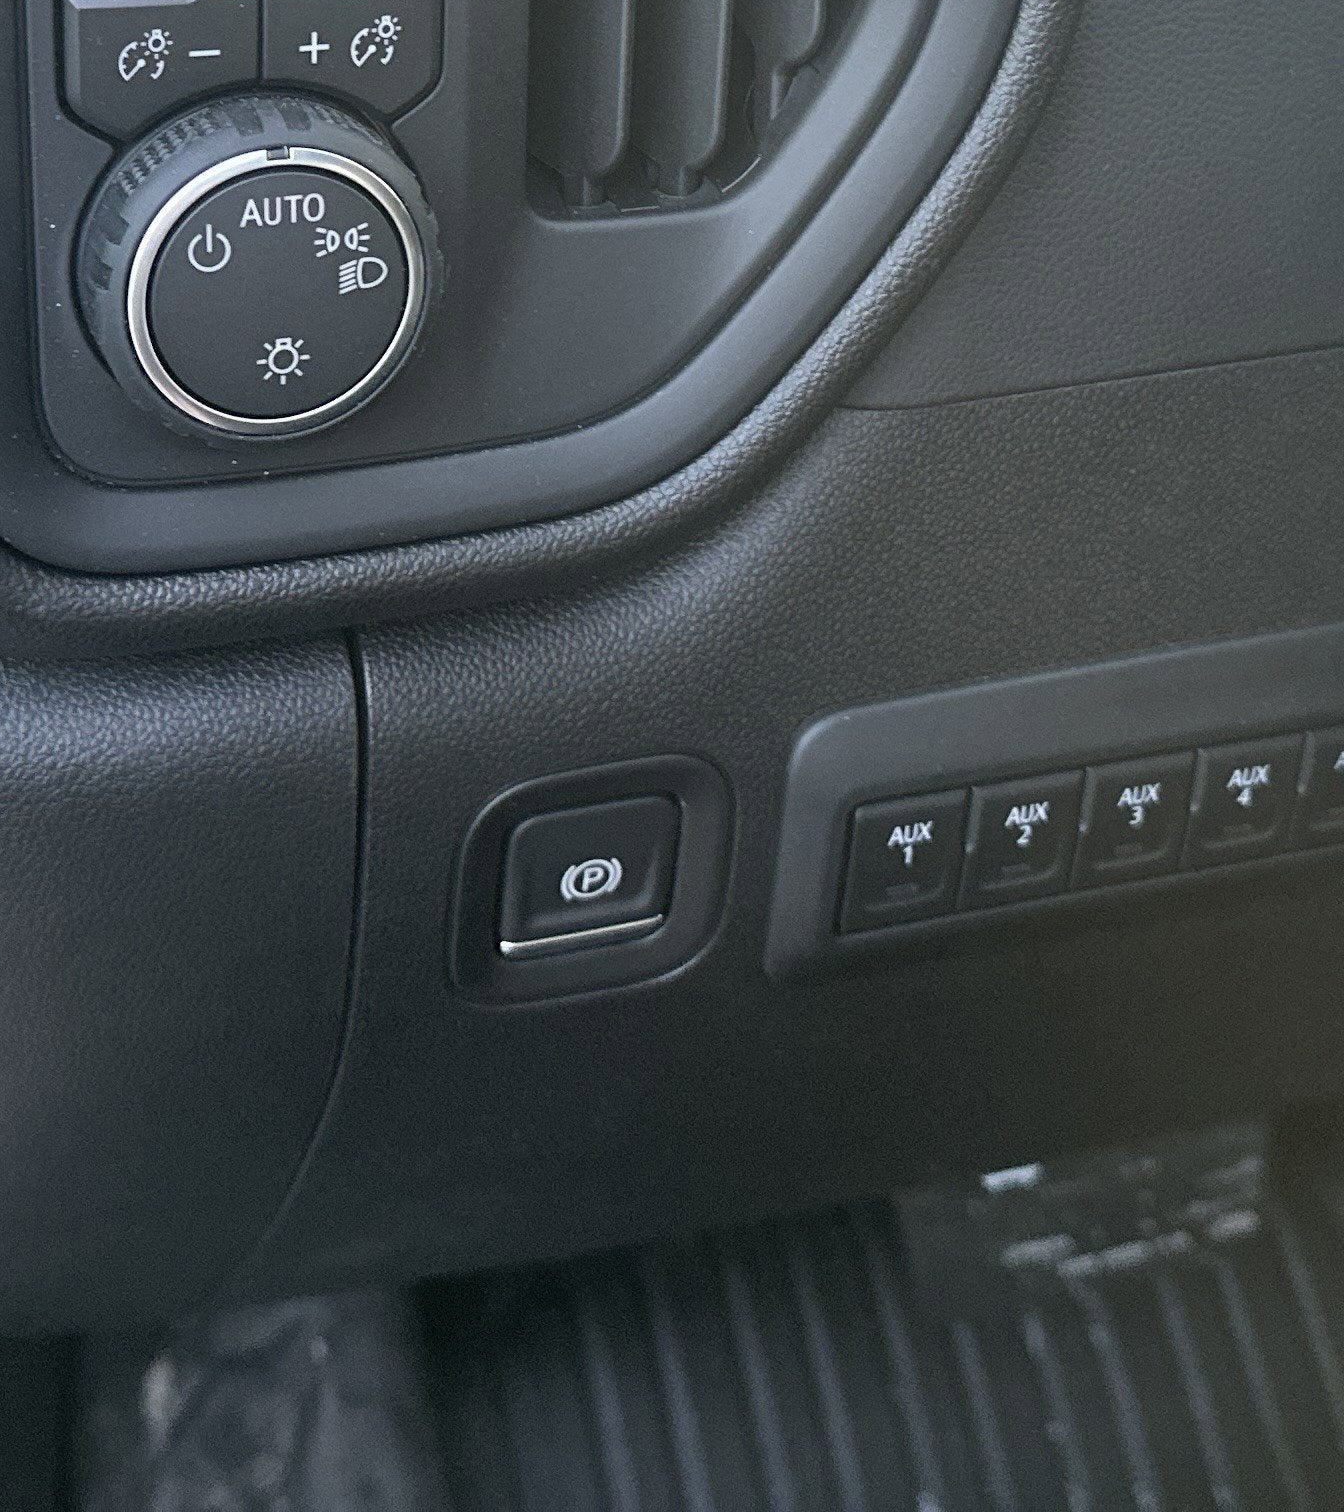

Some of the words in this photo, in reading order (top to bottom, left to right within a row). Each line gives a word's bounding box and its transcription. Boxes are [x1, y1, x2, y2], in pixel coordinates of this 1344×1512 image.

[240, 193, 325, 228] AUTO
[1226, 763, 1272, 789] AUX
[1117, 782, 1161, 808] AUX
[1004, 801, 1050, 827] AUX
[1128, 805, 1145, 828] 3
[887, 820, 934, 849] AUX
[1016, 824, 1033, 848] 2
[903, 844, 915, 866] 1
